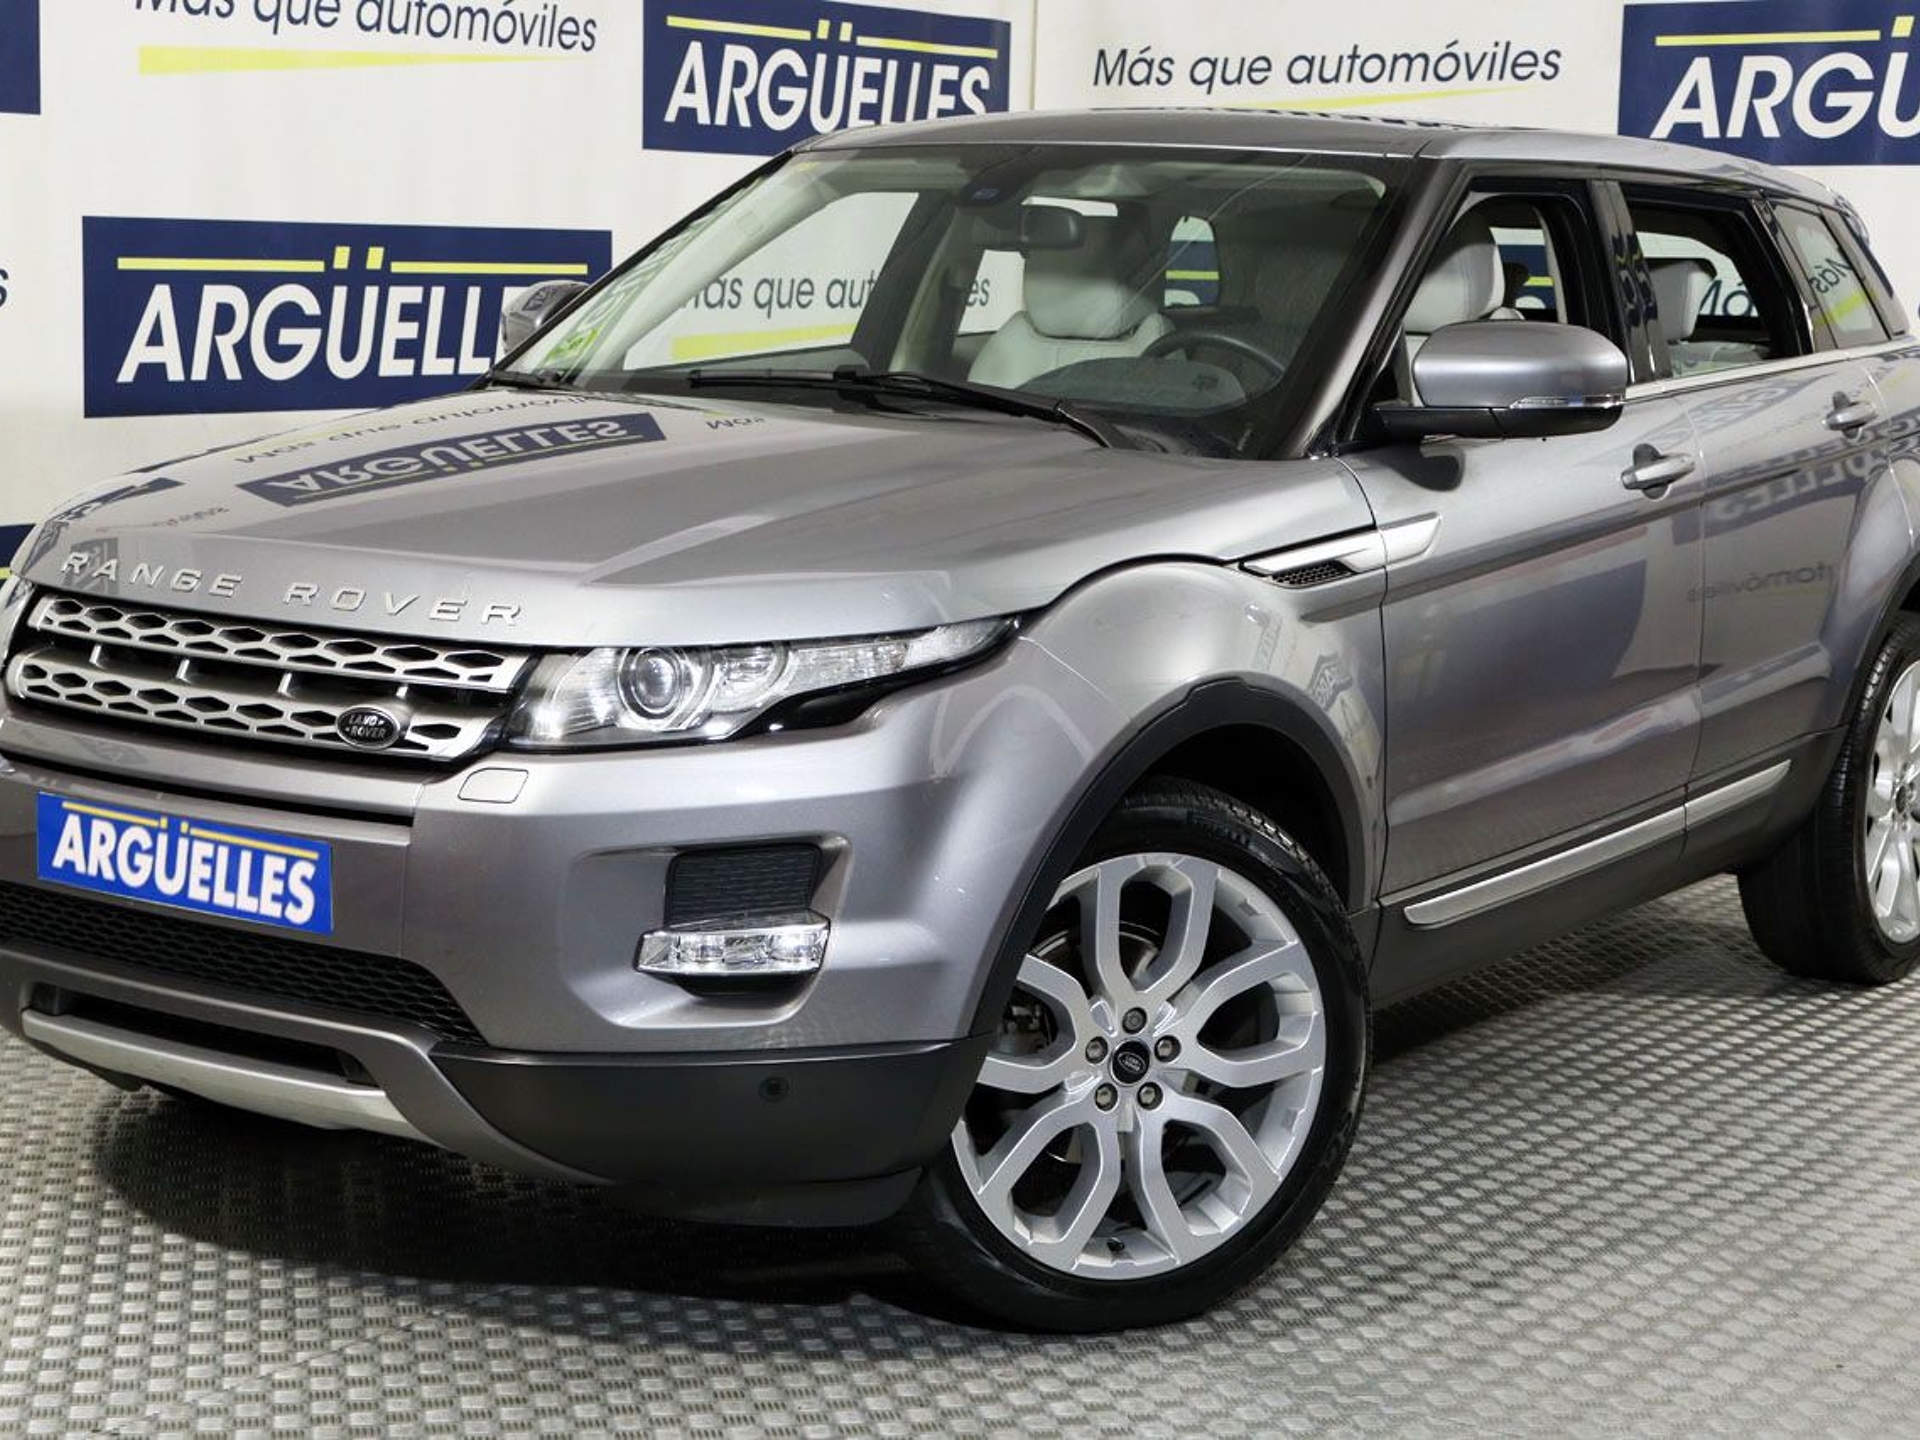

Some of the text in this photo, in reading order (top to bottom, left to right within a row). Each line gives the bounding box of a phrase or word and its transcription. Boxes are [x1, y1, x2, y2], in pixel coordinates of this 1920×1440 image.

[1093, 39, 1562, 95] Más que automóviles
[753, 277, 816, 319] que
[61, 551, 523, 627] RANGE ROVER
[52, 812, 317, 925] ARGÜELLES
